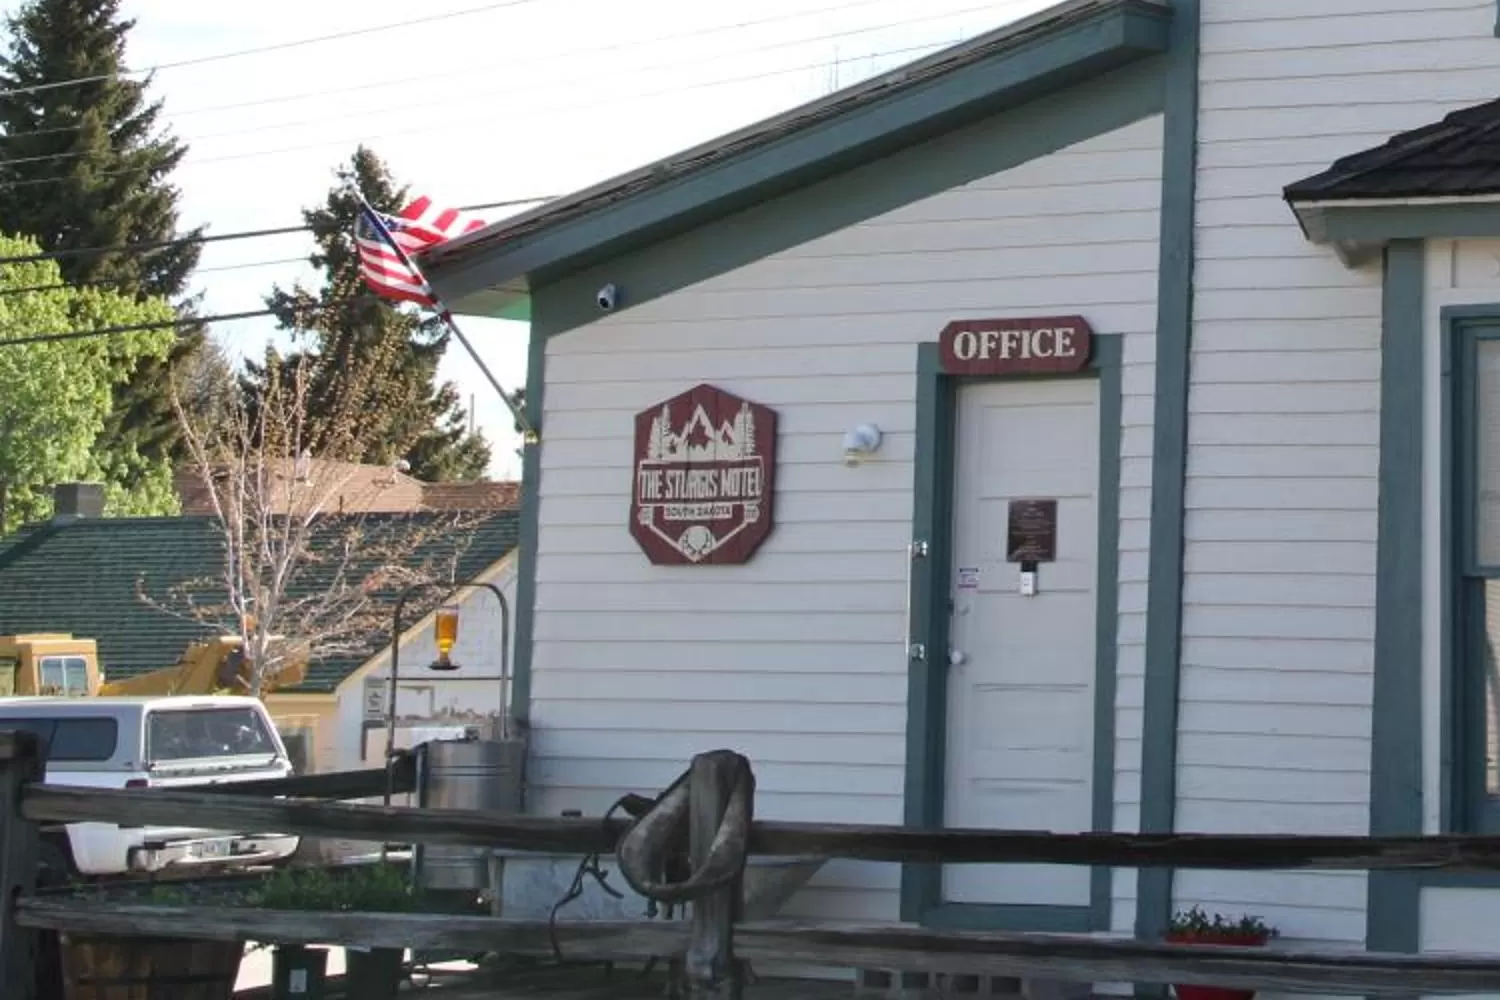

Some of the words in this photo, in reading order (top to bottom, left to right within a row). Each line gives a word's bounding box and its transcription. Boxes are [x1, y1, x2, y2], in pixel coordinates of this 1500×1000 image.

[953, 328, 1076, 360] OFFICE
[640, 470, 663, 499] THE
[665, 468, 718, 499] STURGIS
[721, 466, 762, 497] MOTEL
[665, 507, 695, 517] SOUTH
[696, 505, 731, 517] DAKOTA
